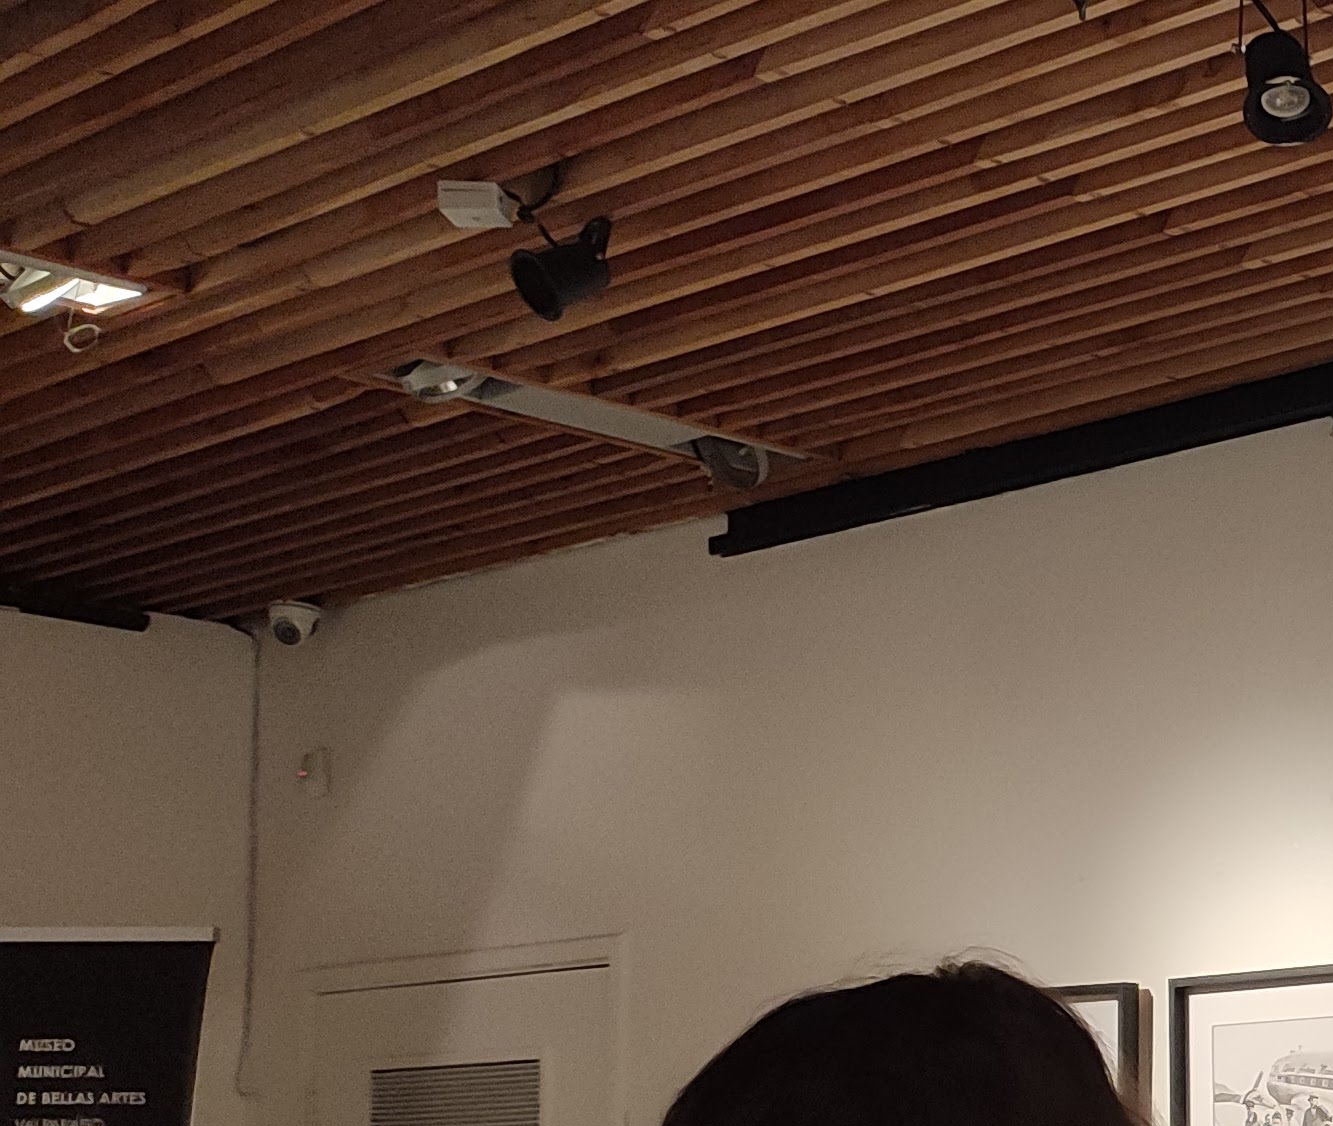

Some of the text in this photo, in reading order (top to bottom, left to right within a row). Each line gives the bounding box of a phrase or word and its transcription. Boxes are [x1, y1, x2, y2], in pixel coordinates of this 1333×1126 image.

[18, 1038, 76, 1052] MUSEO
[17, 1065, 105, 1079] MUNICIPAL
[16, 1091, 147, 1105] DE BELLAS ARTES
